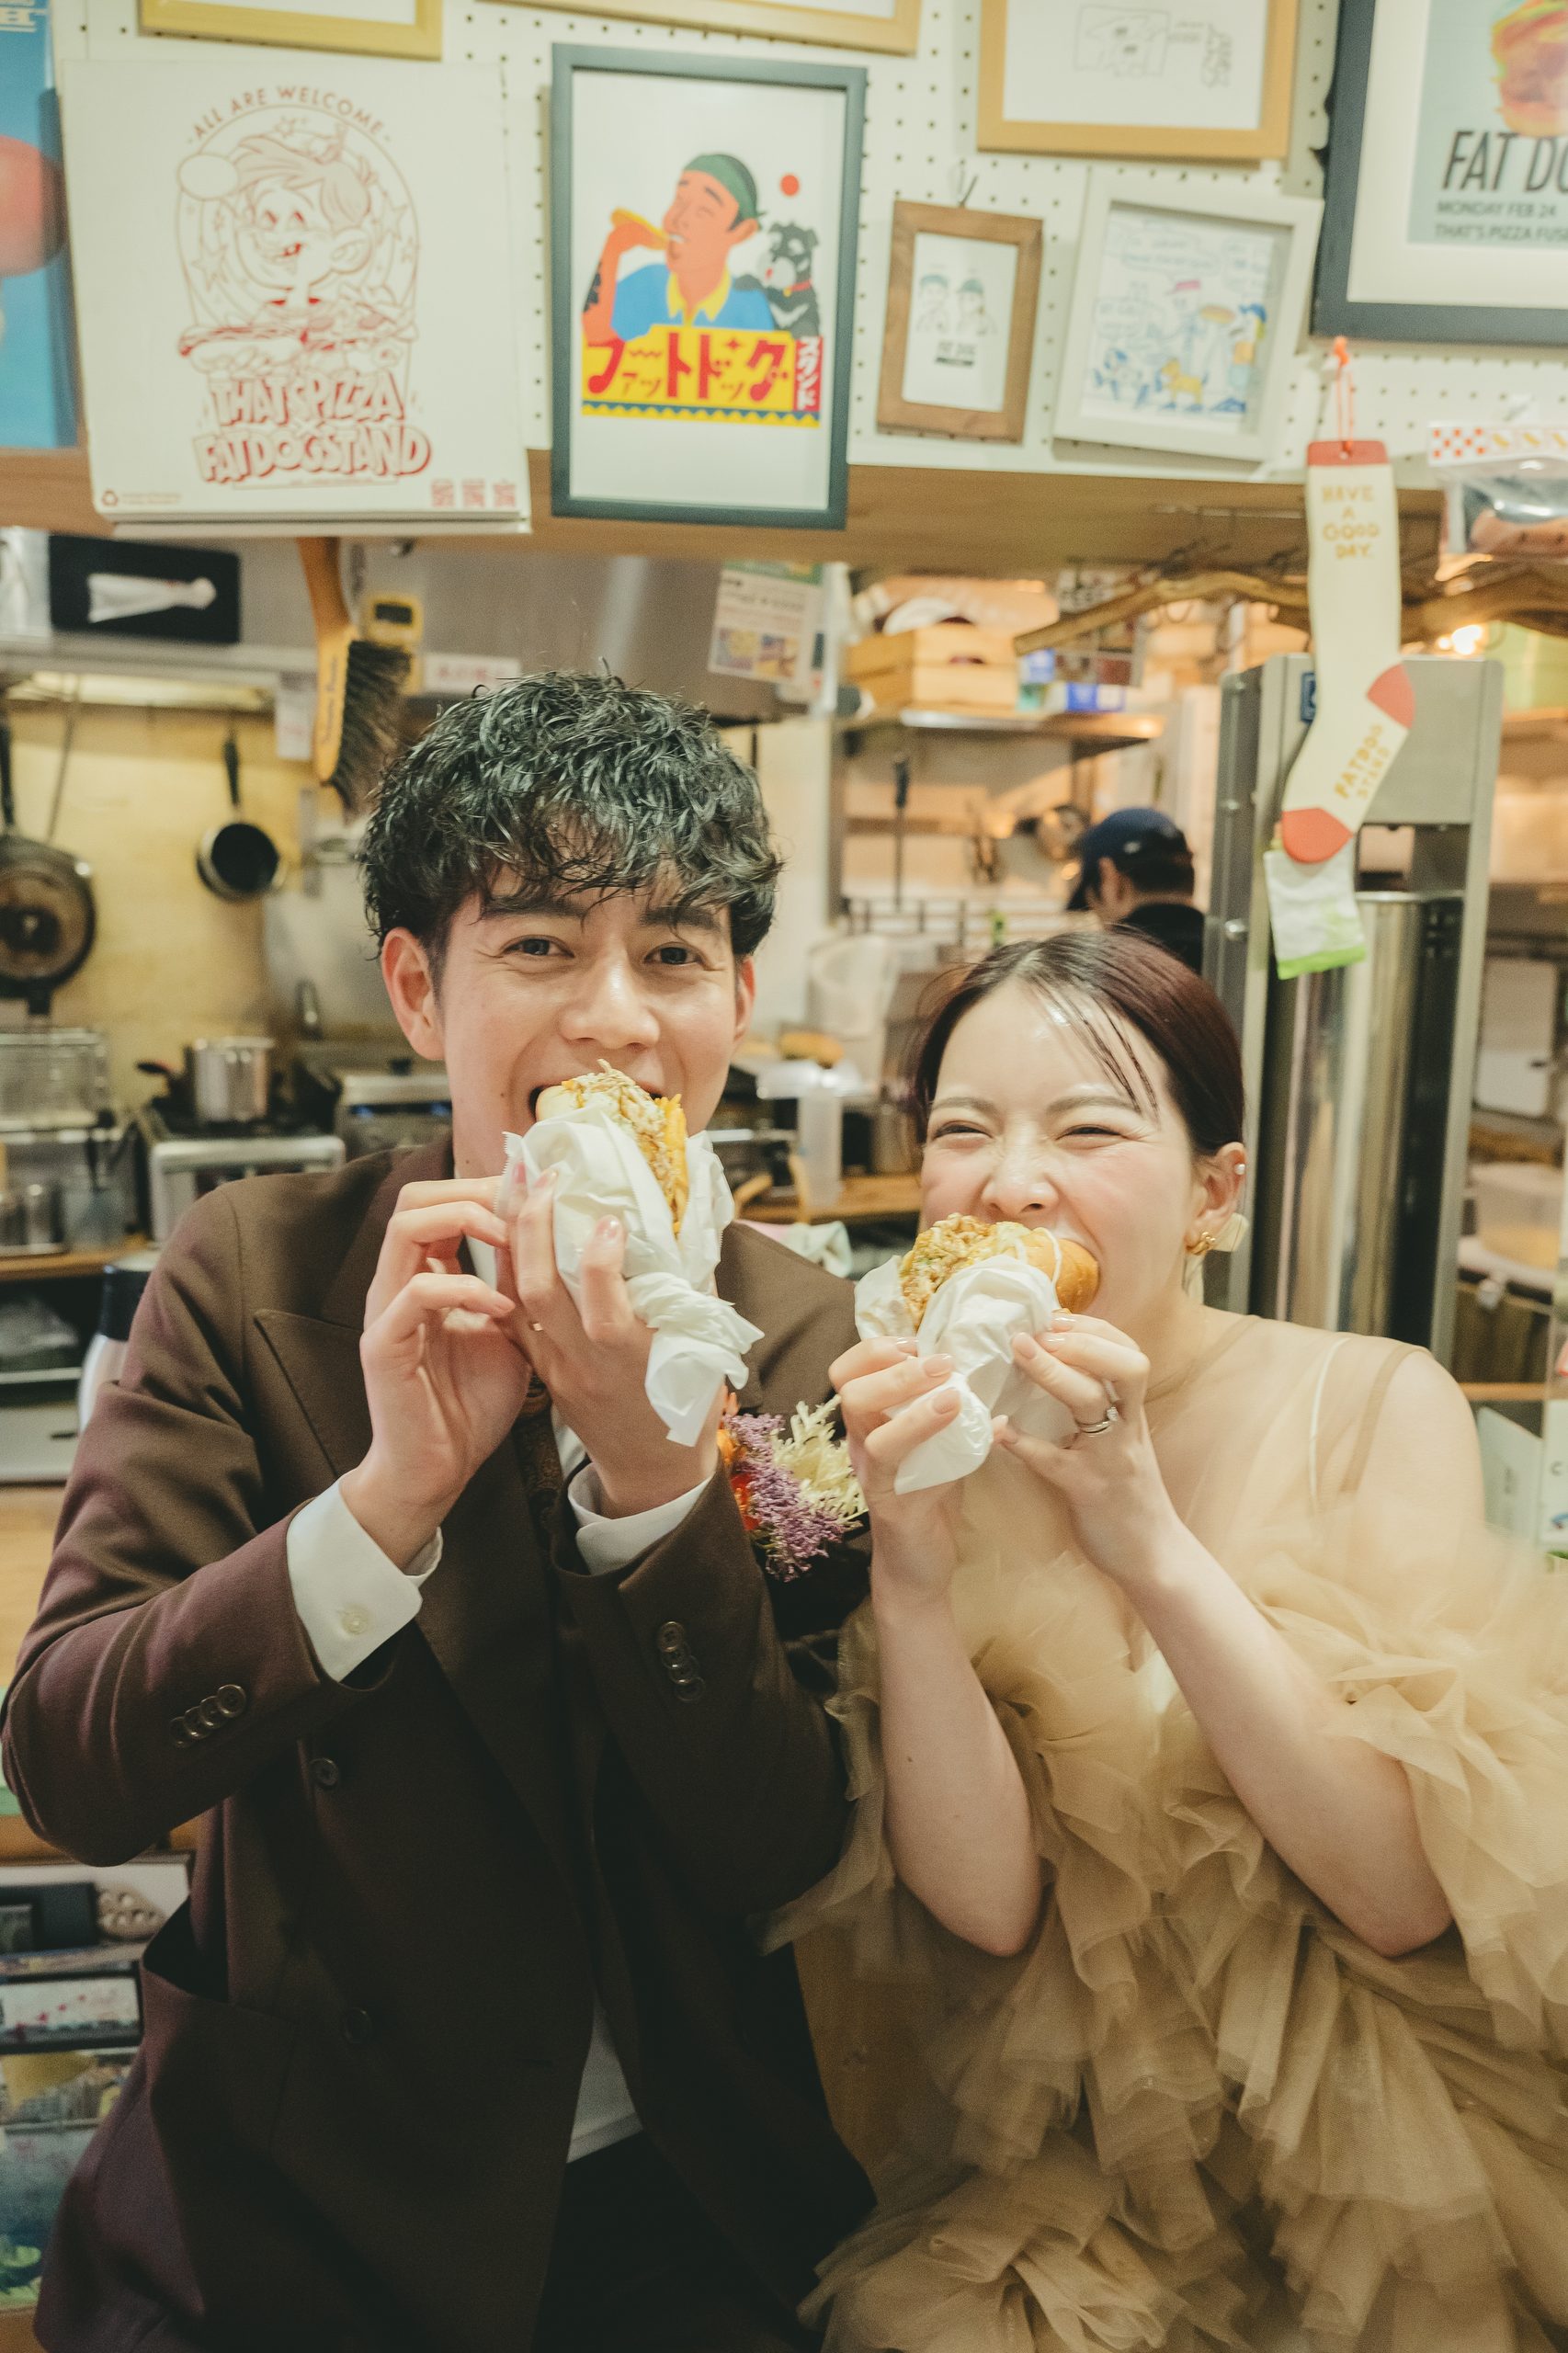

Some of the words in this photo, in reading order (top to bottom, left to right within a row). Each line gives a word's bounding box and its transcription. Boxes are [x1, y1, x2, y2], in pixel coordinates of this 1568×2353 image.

[193, 107, 222, 138] ALL
[231, 88, 265, 113] ARE
[277, 86, 384, 134] WELCOME
[1442, 130, 1518, 189] FAT
[796, 336, 821, 410] スタンド
[1323, 485, 1373, 501] HAVE
[1343, 506, 1356, 519] A
[1323, 522, 1380, 541] GOOD
